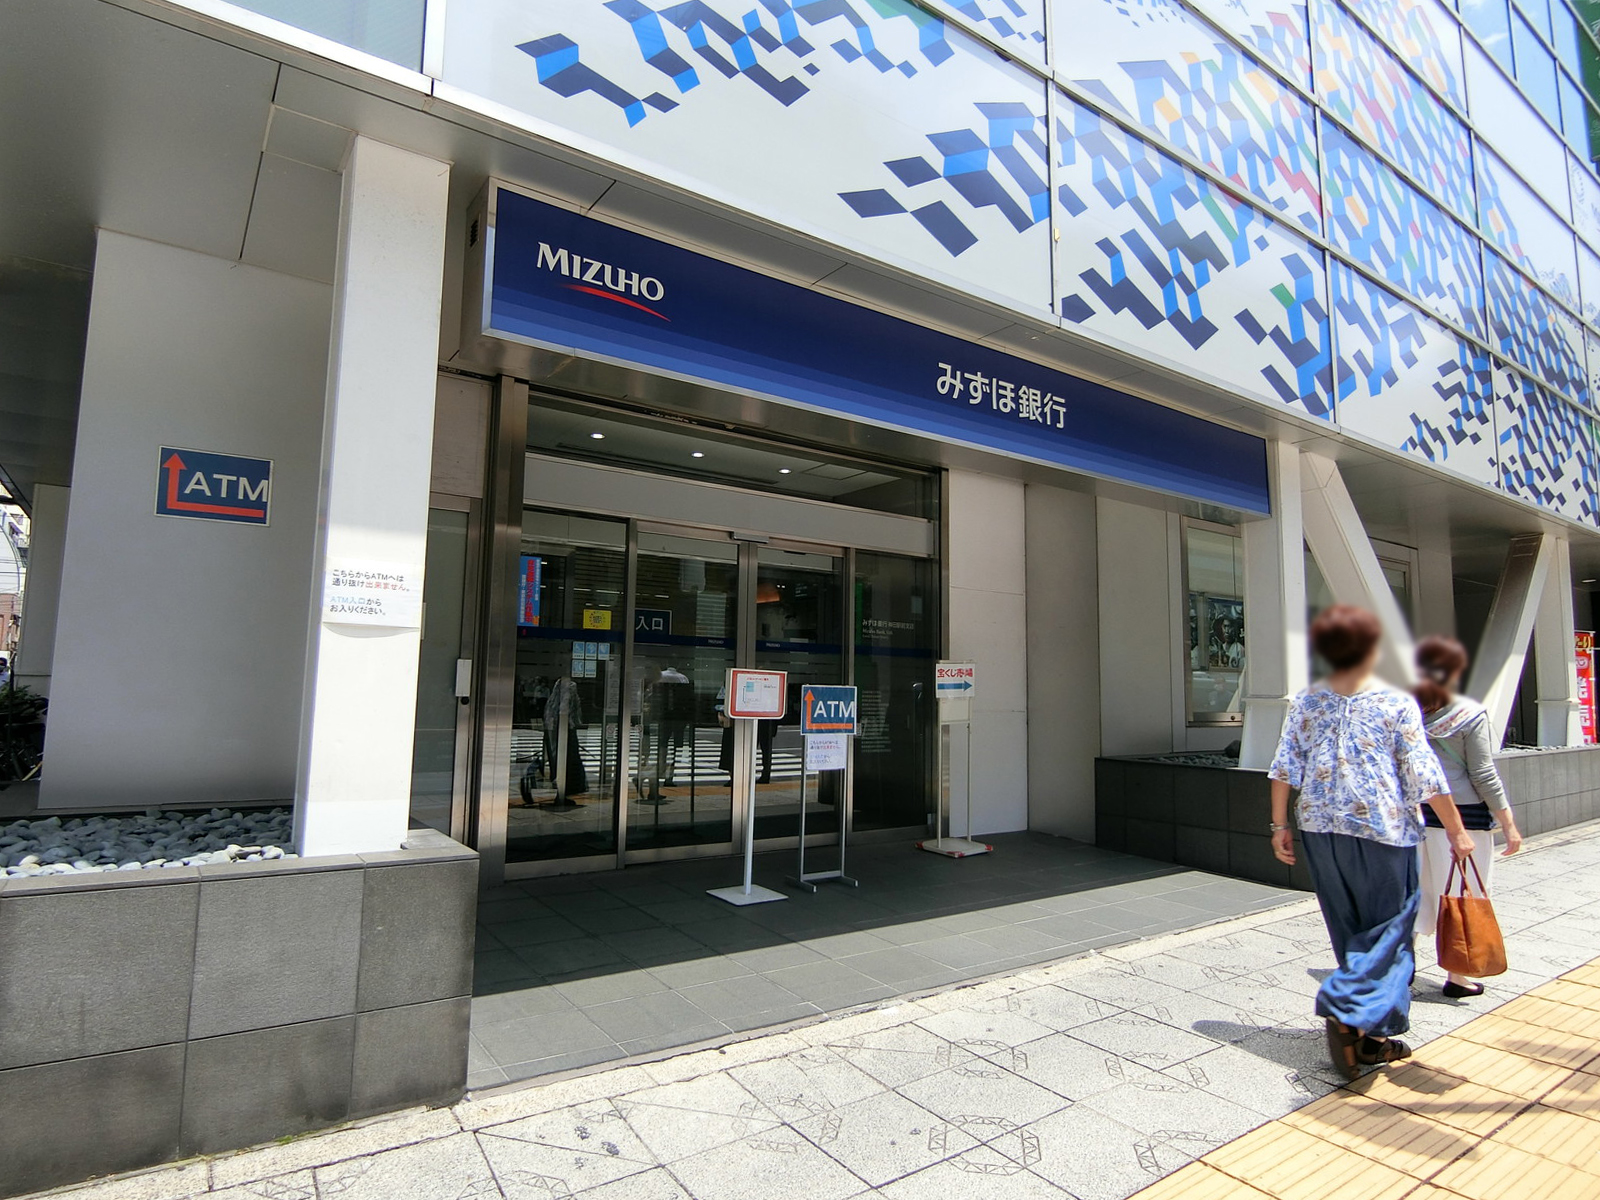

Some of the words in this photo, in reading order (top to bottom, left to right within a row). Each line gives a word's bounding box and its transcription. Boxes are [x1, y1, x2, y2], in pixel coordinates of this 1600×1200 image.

[536, 241, 665, 301] MIZUHO
[936, 361, 1067, 429] みずほ銀行
[183, 471, 270, 503] ATM
[332, 568, 405, 582] こちらからATMへは
[332, 577, 410, 592] 通り抜け出来ません。
[329, 595, 382, 606] ATM入口から
[329, 604, 386, 616] お入りください。
[635, 615, 664, 631] 入口
[813, 700, 855, 719] ATM
